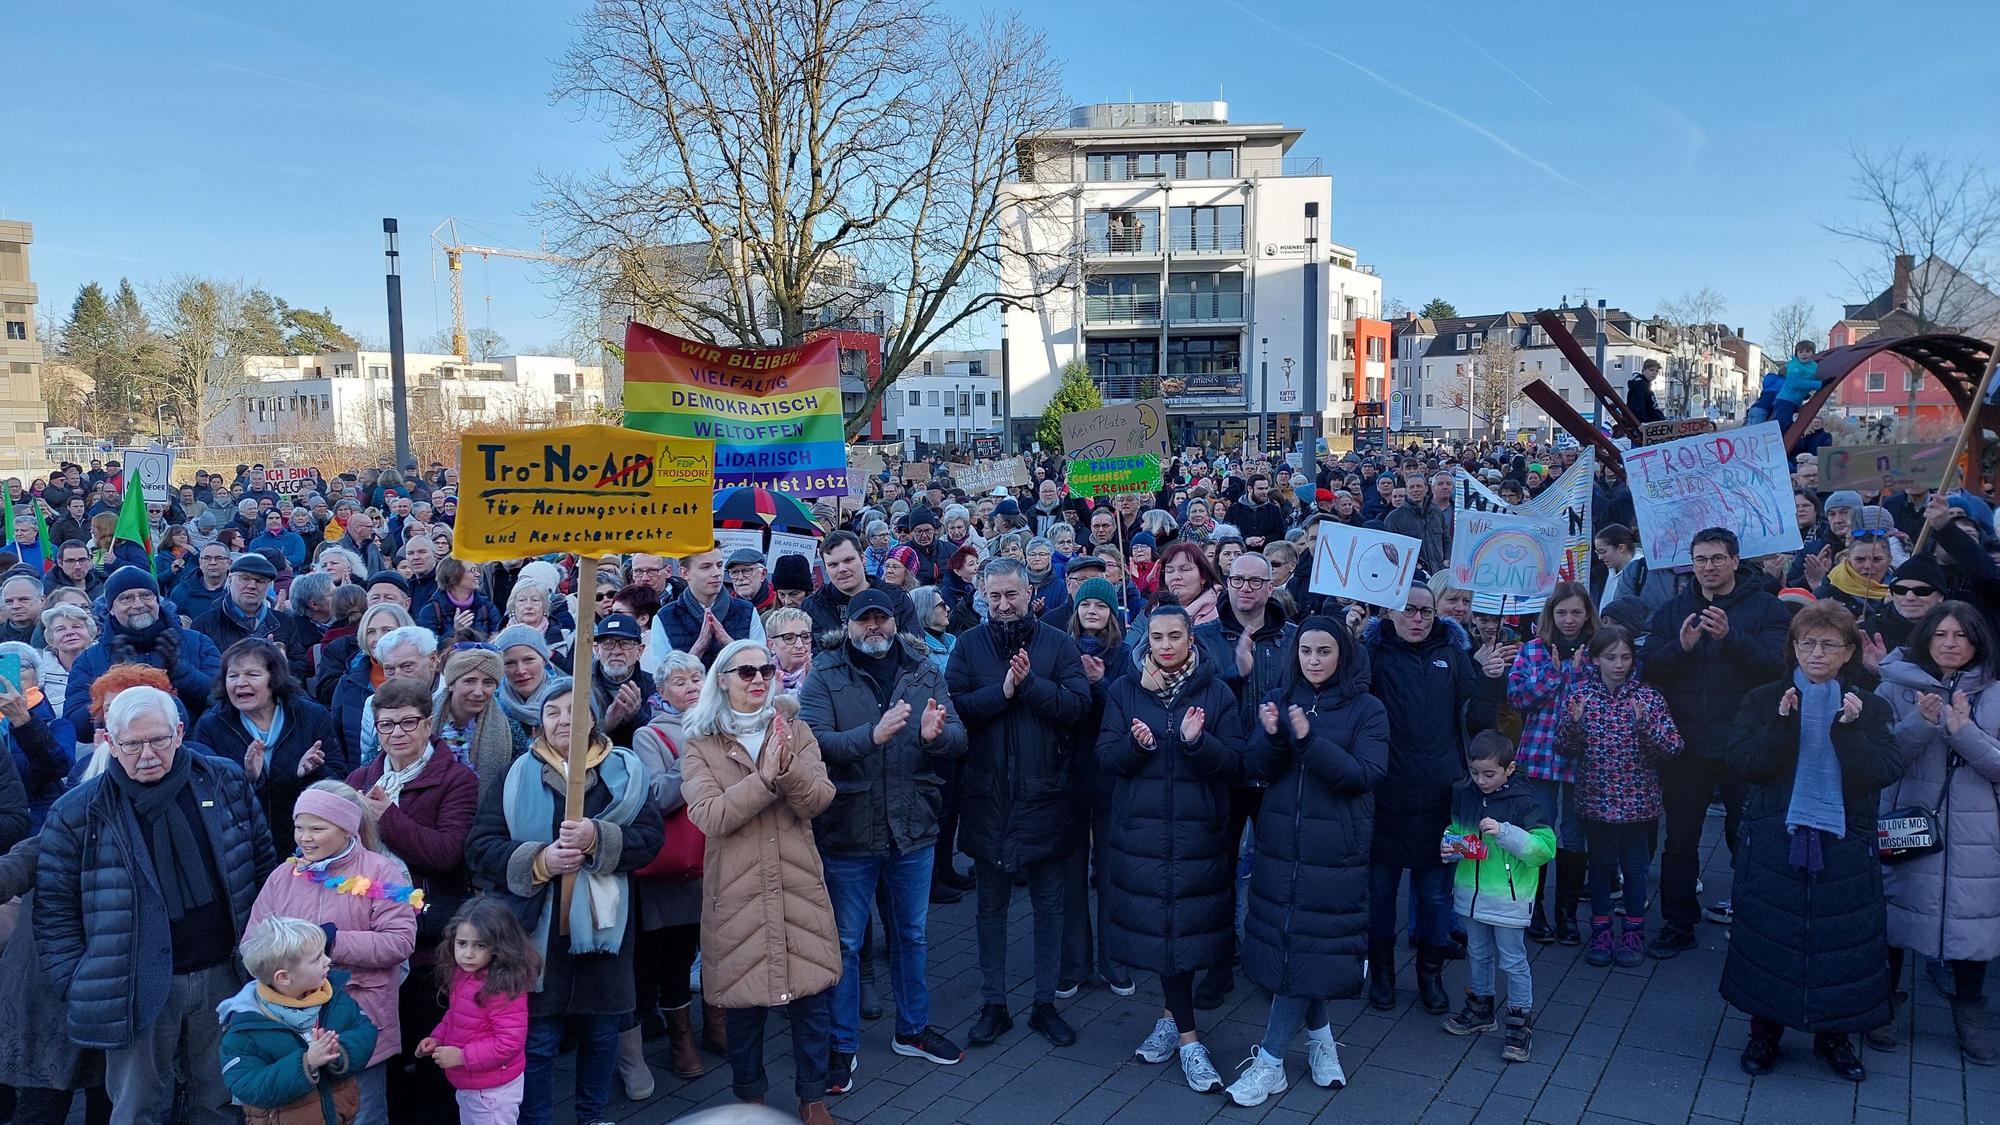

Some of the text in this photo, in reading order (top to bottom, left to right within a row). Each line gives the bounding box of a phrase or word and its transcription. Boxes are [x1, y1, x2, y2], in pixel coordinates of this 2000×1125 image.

[680, 342, 720, 362] WIR
[689, 367, 789, 392] VIELFÄLTIG
[671, 390, 818, 416] DEMOKRATISCH
[693, 420, 804, 440] WELTOFFEN
[1067, 414, 1127, 440] Kein Platz
[1646, 420, 1709, 437] GEGEN STOP
[677, 459, 694, 468] FDP
[715, 450, 811, 467] LIDARISCH
[1089, 458, 1145, 472] FRIEDEN
[1626, 433, 1778, 482] TROISDORF
[265, 468, 308, 480] ICH BIN
[657, 469, 710, 478] TROISDORF
[265, 480, 301, 494] DAGEG
[773, 478, 801, 492] Ist
[805, 474, 847, 491] Jetz
[1092, 480, 1148, 494] FREIHEIT
[485, 499, 520, 516] Für
[1468, 519, 1494, 535] WIR
[485, 528, 673, 545] und Menschenrechte
[1473, 563, 1538, 589] BUNT
[1888, 819, 1907, 830] LOVE
[1880, 836, 1920, 848] MOSCHINO
